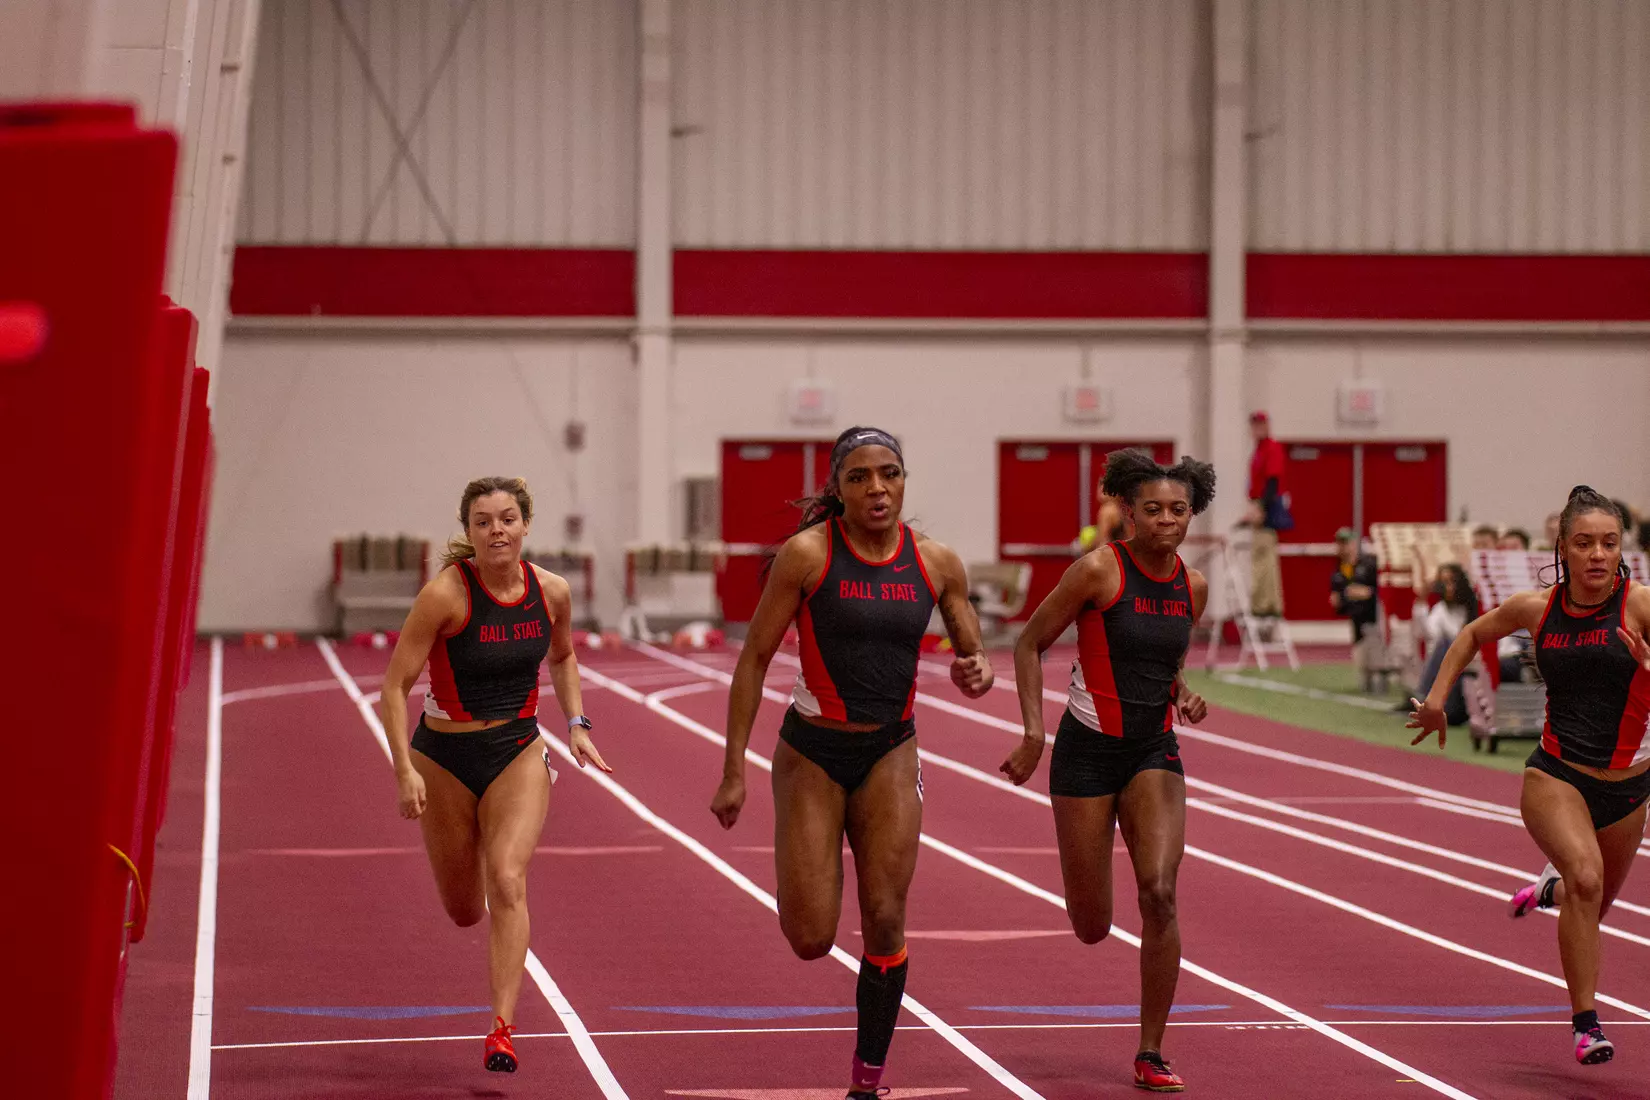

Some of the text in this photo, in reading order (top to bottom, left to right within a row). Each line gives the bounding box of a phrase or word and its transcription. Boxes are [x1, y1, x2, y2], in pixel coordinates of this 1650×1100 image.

[840, 580, 918, 602] BALL STATE
[1134, 597, 1189, 618] BALL STATE
[479, 620, 543, 642] BALL STATE
[1542, 629, 1609, 649] BALL STATE
